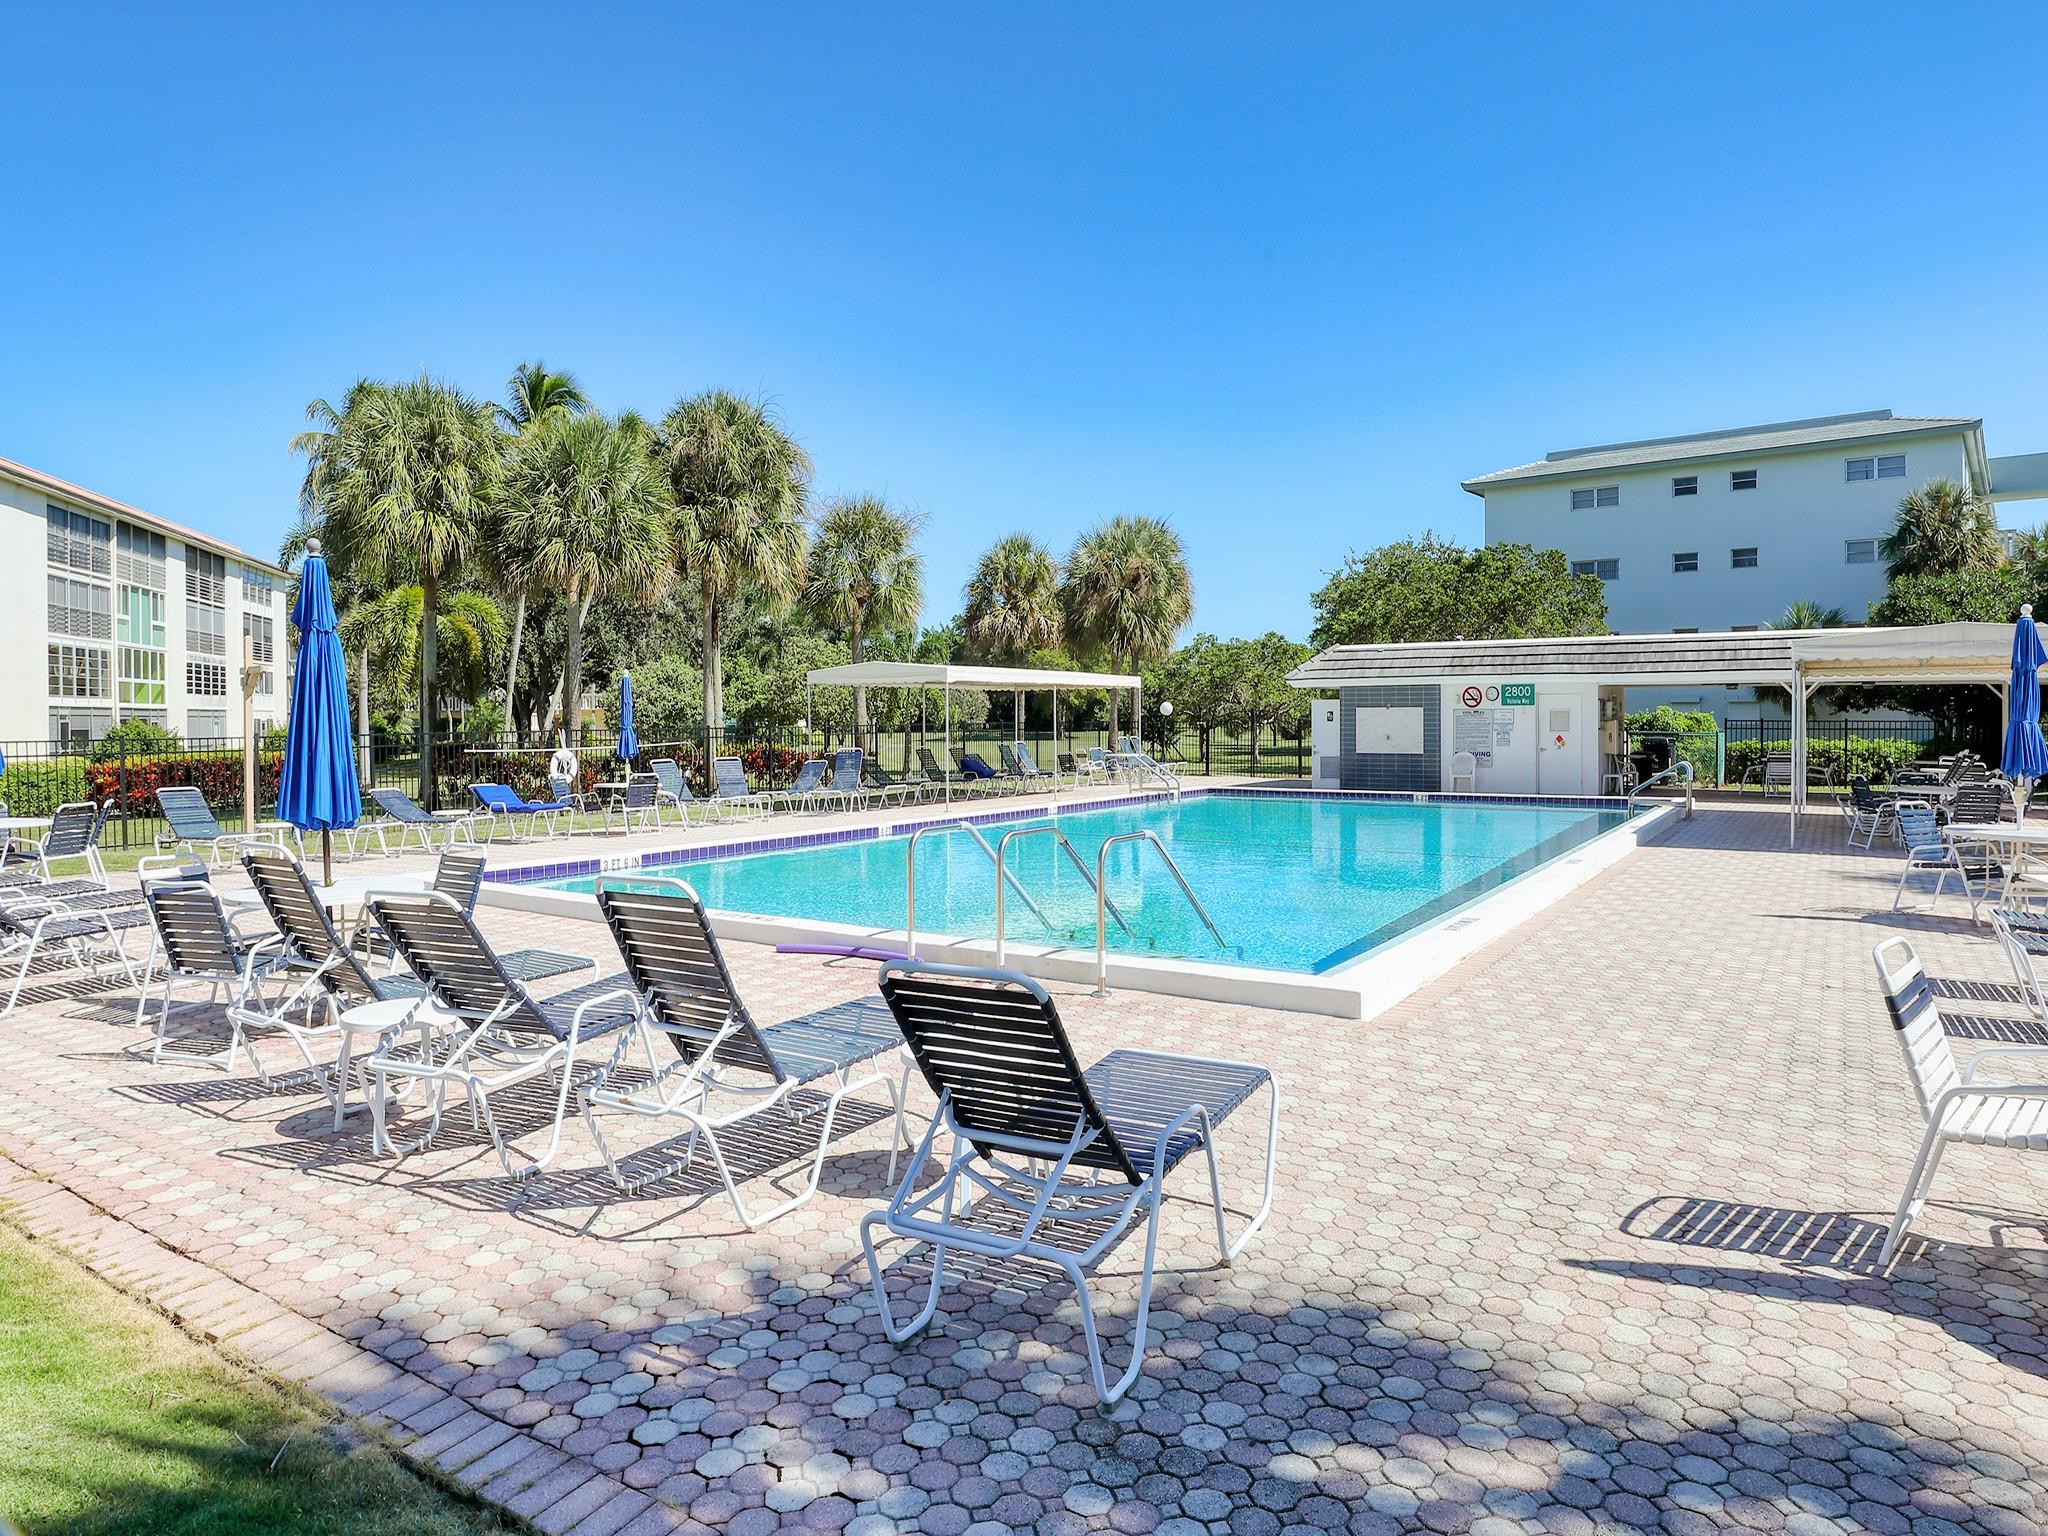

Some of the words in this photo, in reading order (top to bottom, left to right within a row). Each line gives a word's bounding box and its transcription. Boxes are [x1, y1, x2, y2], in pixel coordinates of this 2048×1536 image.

[1505, 686, 1531, 697] 2800
[611, 859, 620, 871] FT
[631, 857, 639, 868] IN
